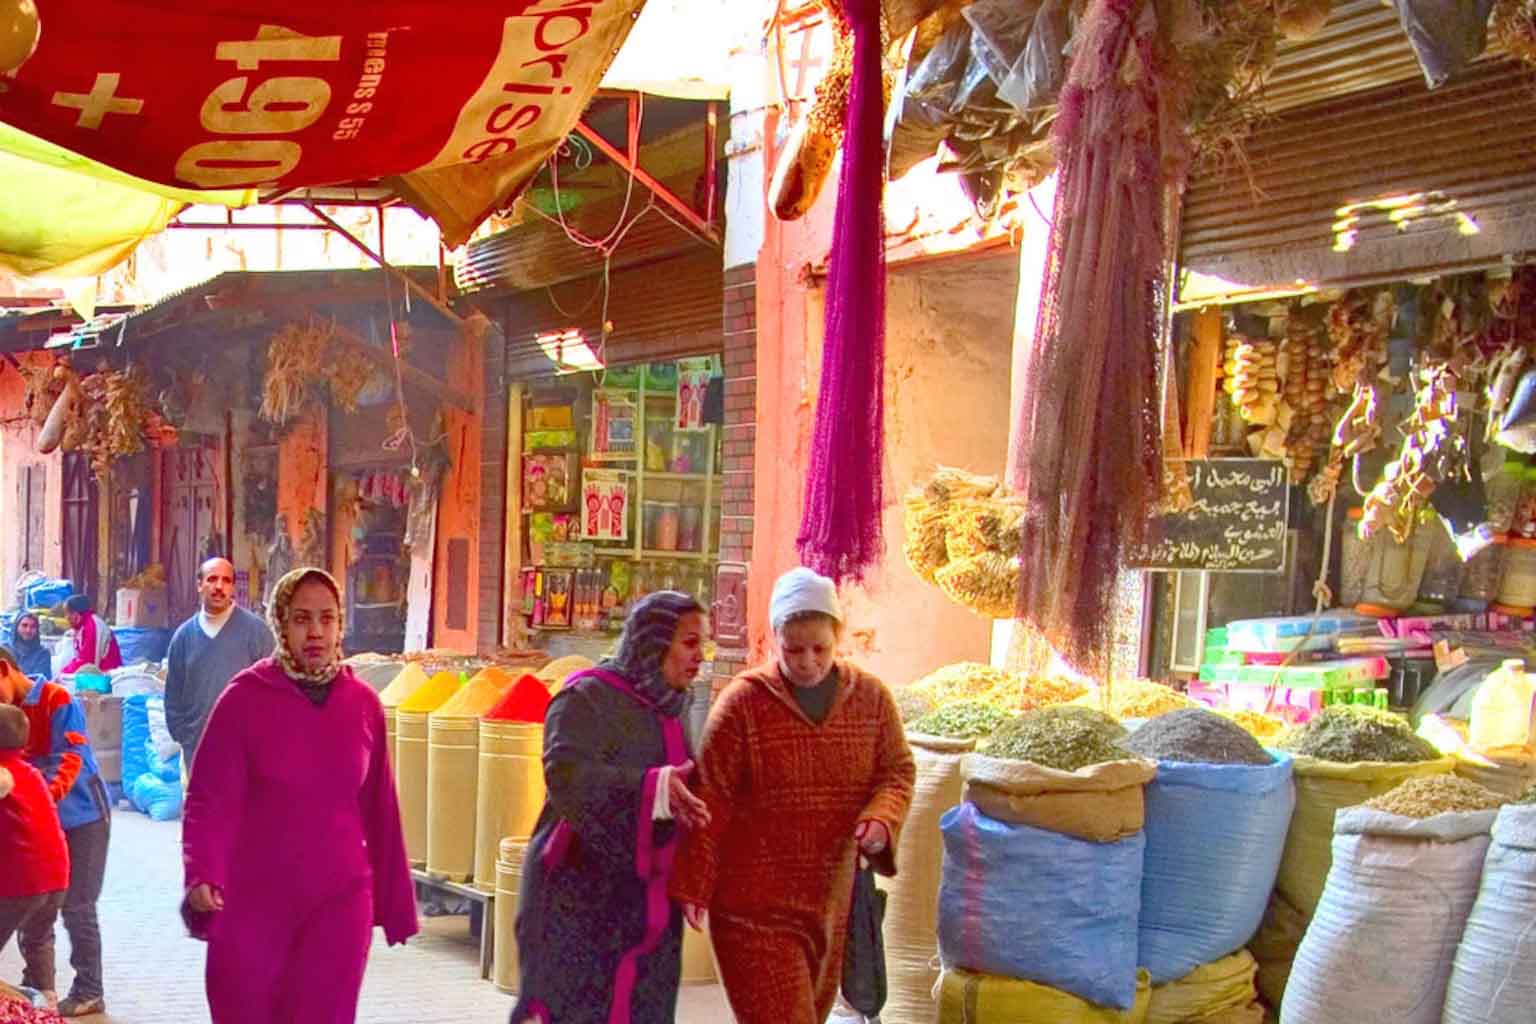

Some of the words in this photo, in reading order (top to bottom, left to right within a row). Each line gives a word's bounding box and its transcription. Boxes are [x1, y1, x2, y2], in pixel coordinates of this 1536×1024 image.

[174, 25, 341, 188] 490
[353, 32, 390, 99] mens
[462, 0, 603, 165] prise
[334, 117, 365, 140] 55
